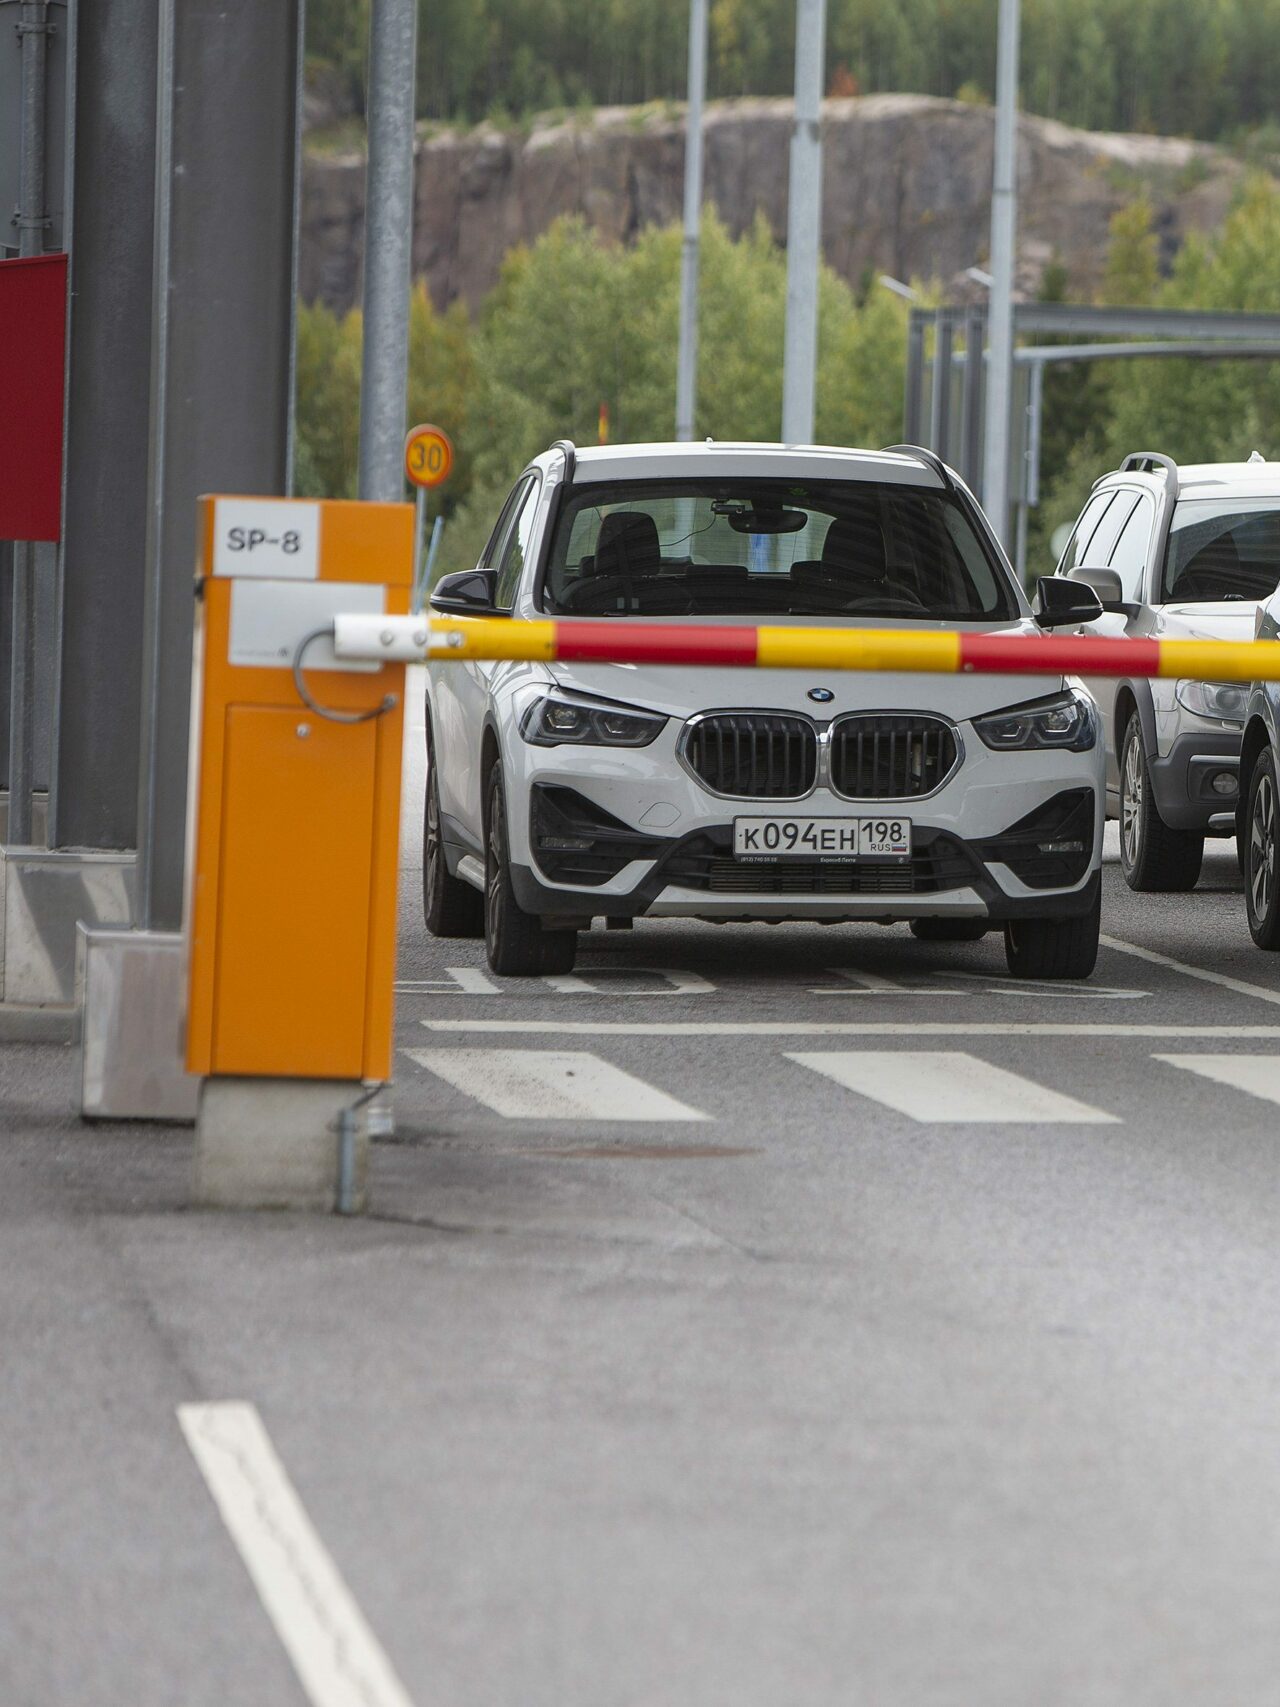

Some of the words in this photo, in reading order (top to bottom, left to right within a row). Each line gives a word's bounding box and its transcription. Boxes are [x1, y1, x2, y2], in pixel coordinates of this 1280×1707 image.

[411, 442, 442, 472] 30
[227, 527, 300, 554] SP-8
[861, 821, 902, 843] 198
[870, 843, 891, 852] RUS
